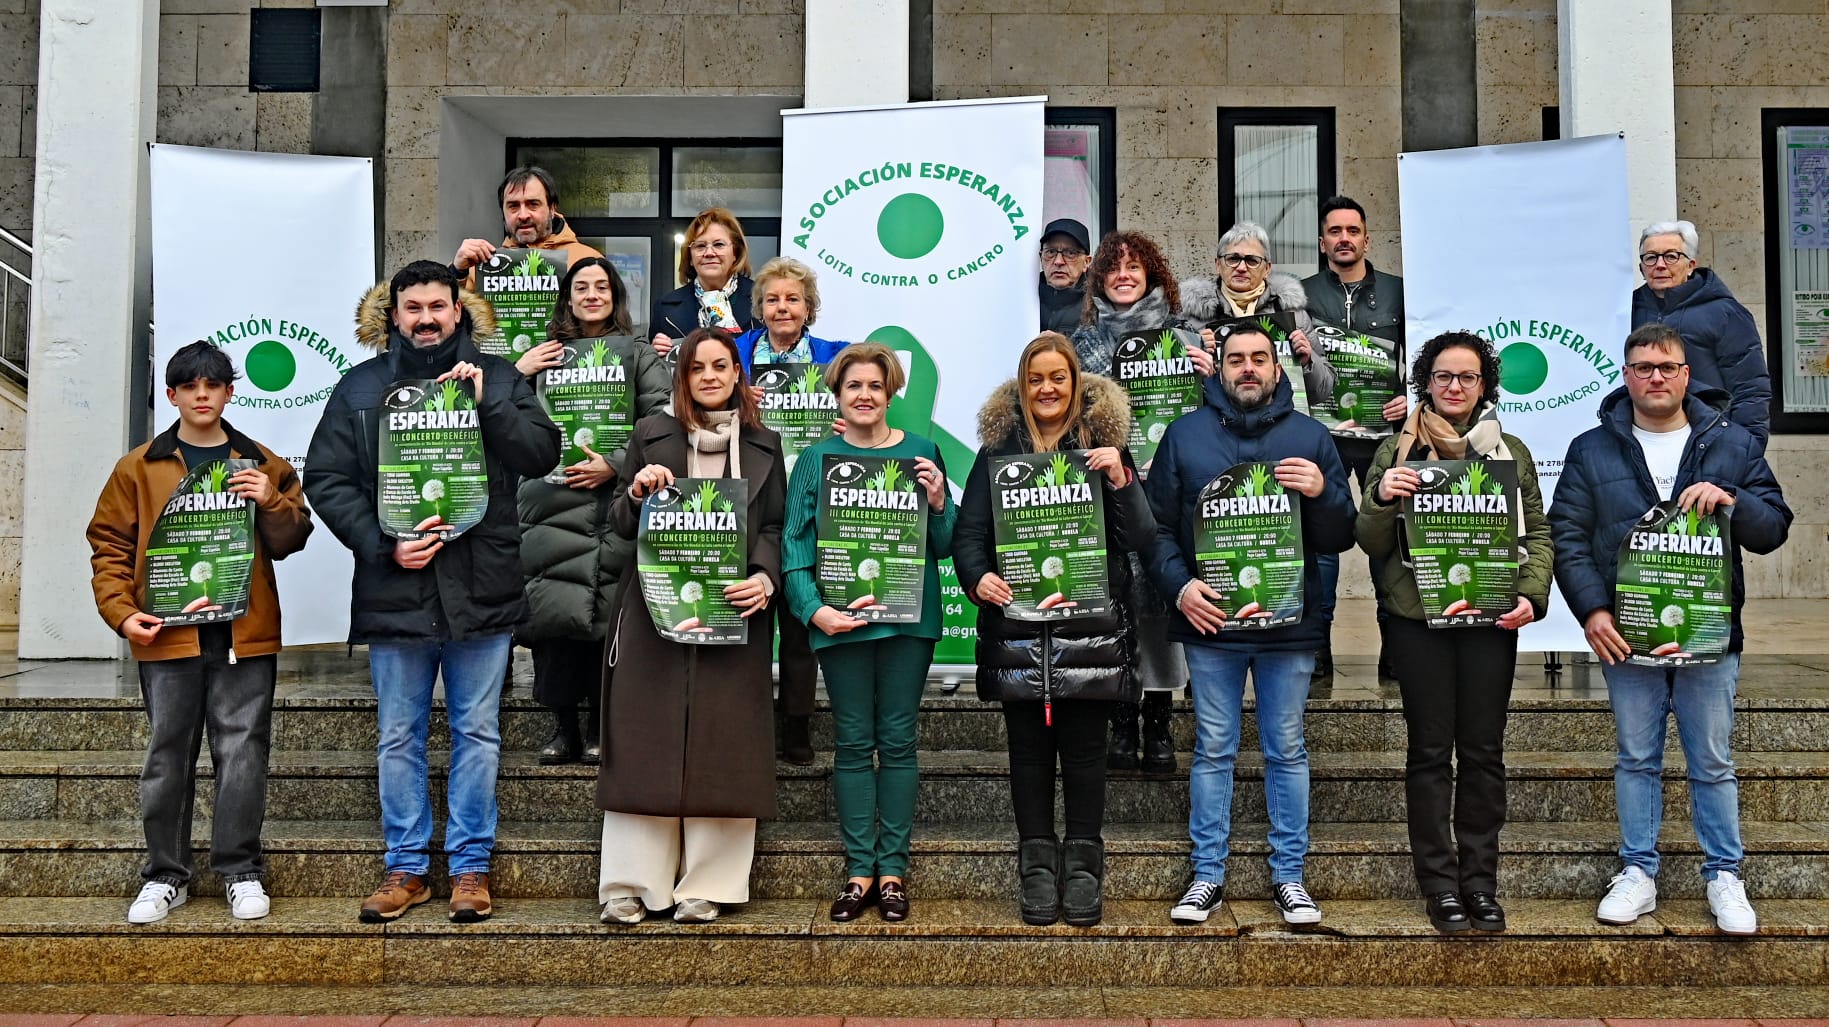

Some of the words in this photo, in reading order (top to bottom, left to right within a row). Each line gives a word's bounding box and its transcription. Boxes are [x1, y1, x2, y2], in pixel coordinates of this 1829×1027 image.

[793, 161, 911, 250] ASOCIACIÓN
[920, 162, 1029, 241] ESPERANZA
[818, 248, 853, 278] LOITA
[861, 271, 919, 286] CONTRA
[928, 273, 939, 284] O
[947, 244, 1004, 280] CANCRO
[483, 275, 559, 292] ESPERANZA
[279, 319, 354, 376] ESPERANZ
[1529, 320, 1621, 384] ESPERANZA
[546, 365, 626, 385] ESPERANZA
[1120, 358, 1194, 380] ESPERANZA
[545, 387, 554, 395] III
[556, 385, 591, 394] CONCERTO
[592, 383, 626, 393] BENÉFICO
[1130, 379, 1162, 389] CONCERTO
[1164, 375, 1195, 387] BENÉFICO
[231, 394, 281, 409] CONTRA
[285, 398, 293, 408] O
[1497, 402, 1532, 412] NTRA
[1535, 400, 1545, 410] O
[1548, 380, 1600, 409] CANCRO
[389, 410, 478, 430] ESPERANZA
[767, 411, 802, 420] CONCERTO
[804, 410, 838, 420] BENÉFICO
[390, 433, 399, 442] III
[402, 432, 441, 441] CONCERTO
[443, 430, 479, 440] BENÉFICO
[164, 491, 246, 516] ESPERANZA
[830, 487, 919, 511] ESPERANZA
[1001, 483, 1093, 509] ESPERANZA
[1202, 494, 1291, 518] ESPERANZA
[1413, 494, 1508, 514] ESPERANZA
[169, 513, 209, 524] CONCERTO
[211, 510, 247, 521] BENÉFICO
[648, 511, 737, 531] ESPERANZA
[829, 509, 839, 518] III
[841, 510, 880, 520] CONCERTO
[882, 511, 919, 522] BENÉFICO
[1004, 511, 1013, 521] III
[1015, 508, 1055, 520] CONCERTO
[1057, 504, 1094, 515] BENÉFICO
[1203, 520, 1212, 529] III
[1215, 517, 1253, 529] CONCERTO
[1255, 514, 1292, 526] BENÉFICO
[1414, 515, 1423, 525] III
[1426, 515, 1467, 525] CONCERTO
[1469, 514, 1508, 525] BENÉFICO
[648, 533, 657, 542] III
[659, 533, 698, 542] CONCERTO
[700, 531, 738, 542] BENÉFICO
[1629, 531, 1724, 556] ESPERANZA
[1629, 553, 1638, 561] III
[1641, 553, 1682, 565] CONCERTO
[1685, 556, 1724, 568] BENÉFICO
